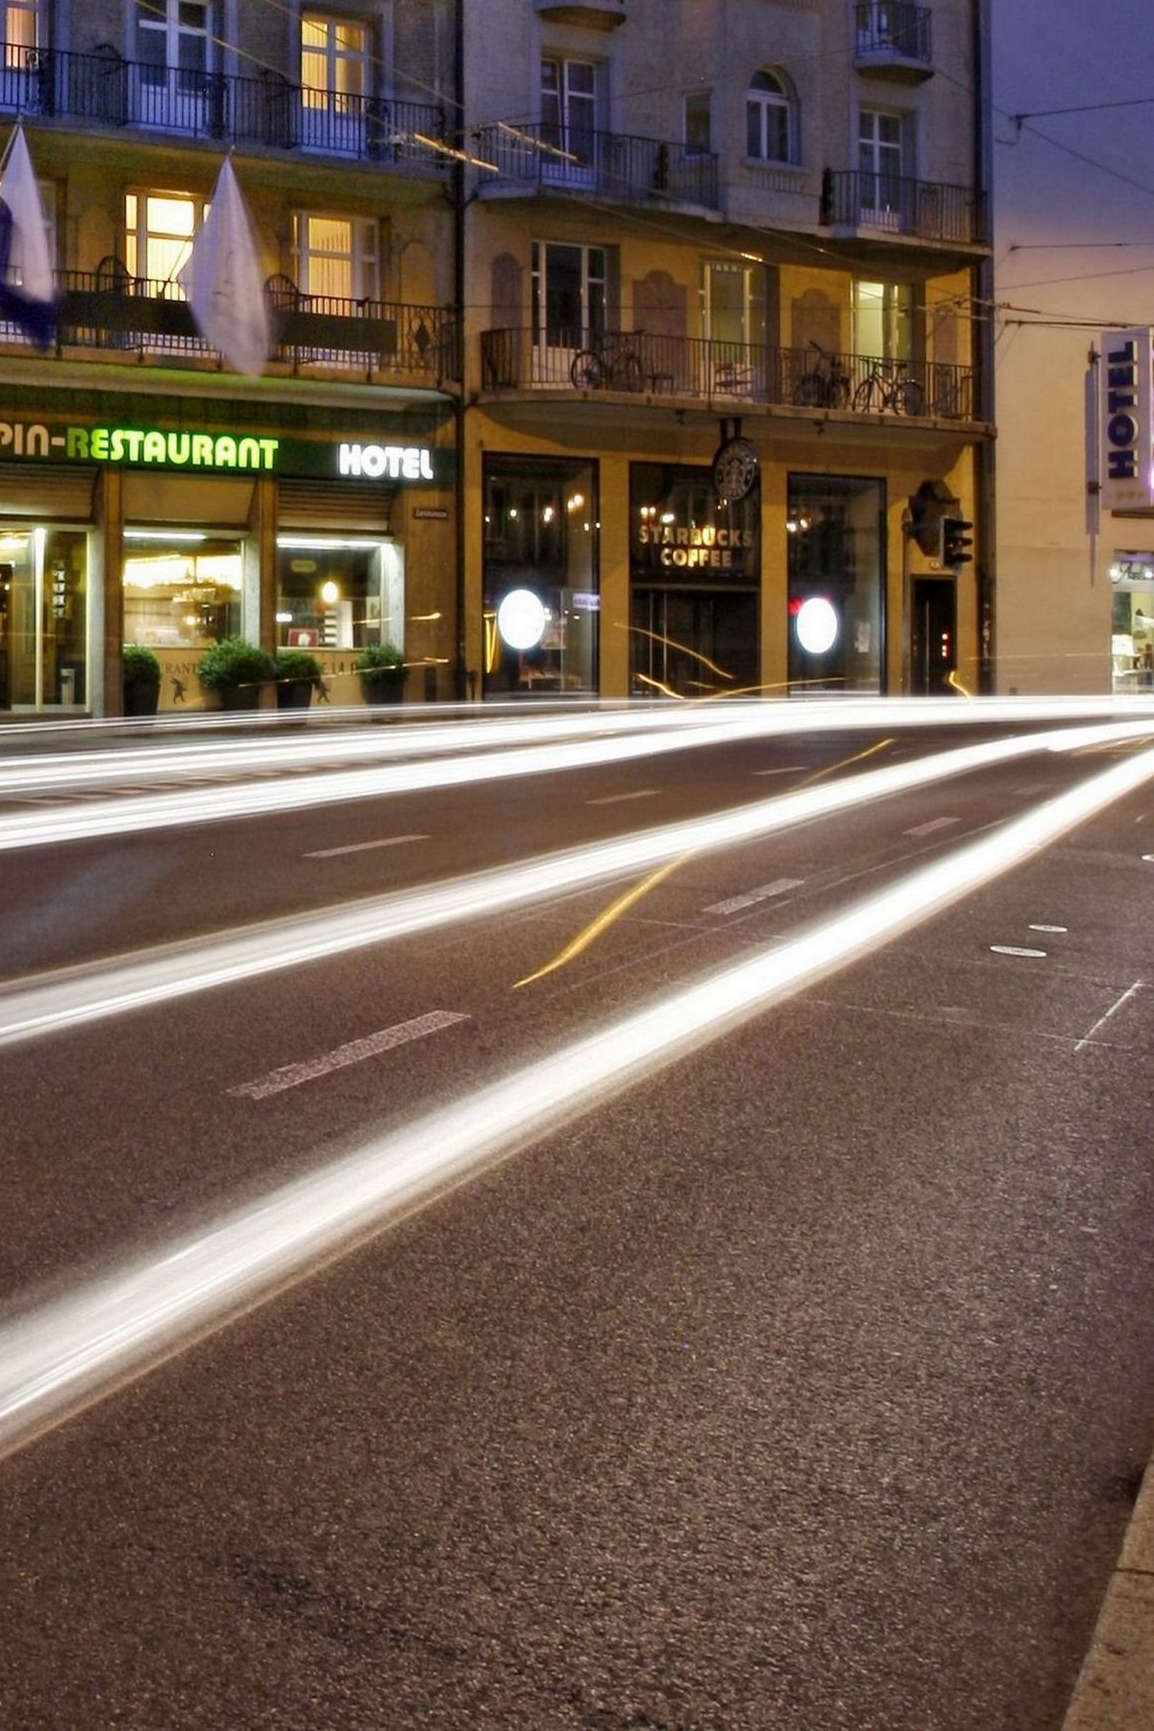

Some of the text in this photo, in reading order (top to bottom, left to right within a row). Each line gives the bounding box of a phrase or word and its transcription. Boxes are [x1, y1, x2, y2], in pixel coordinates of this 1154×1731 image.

[1107, 341, 1138, 479] HOTEL
[339, 443, 434, 480] HOTEL
[639, 525, 752, 547] STARBUCKS
[660, 548, 732, 567] COFFEE
